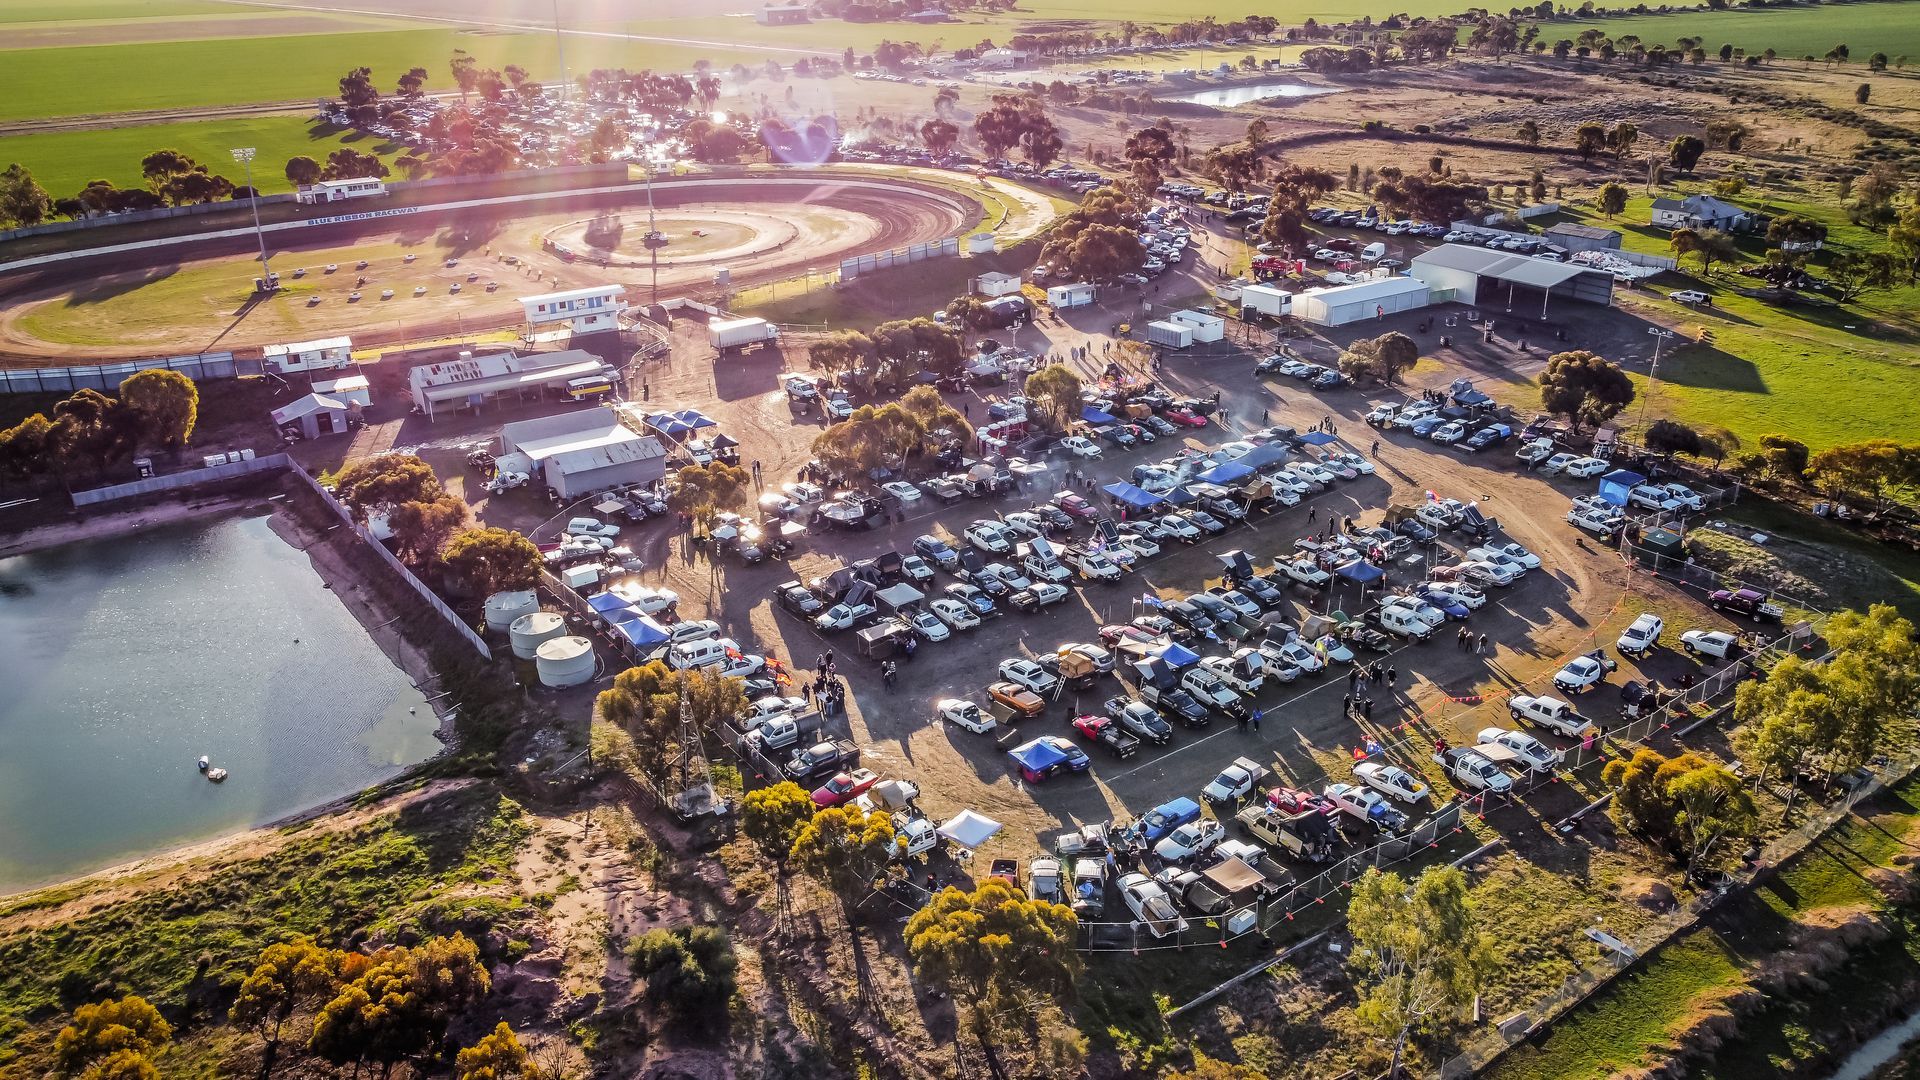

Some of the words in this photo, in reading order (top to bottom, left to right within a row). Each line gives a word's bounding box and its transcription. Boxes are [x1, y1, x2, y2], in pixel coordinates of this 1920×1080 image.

[308, 217, 332, 225] BLUE
[334, 212, 372, 221] RIBBON
[375, 207, 418, 216] RACEWAY
